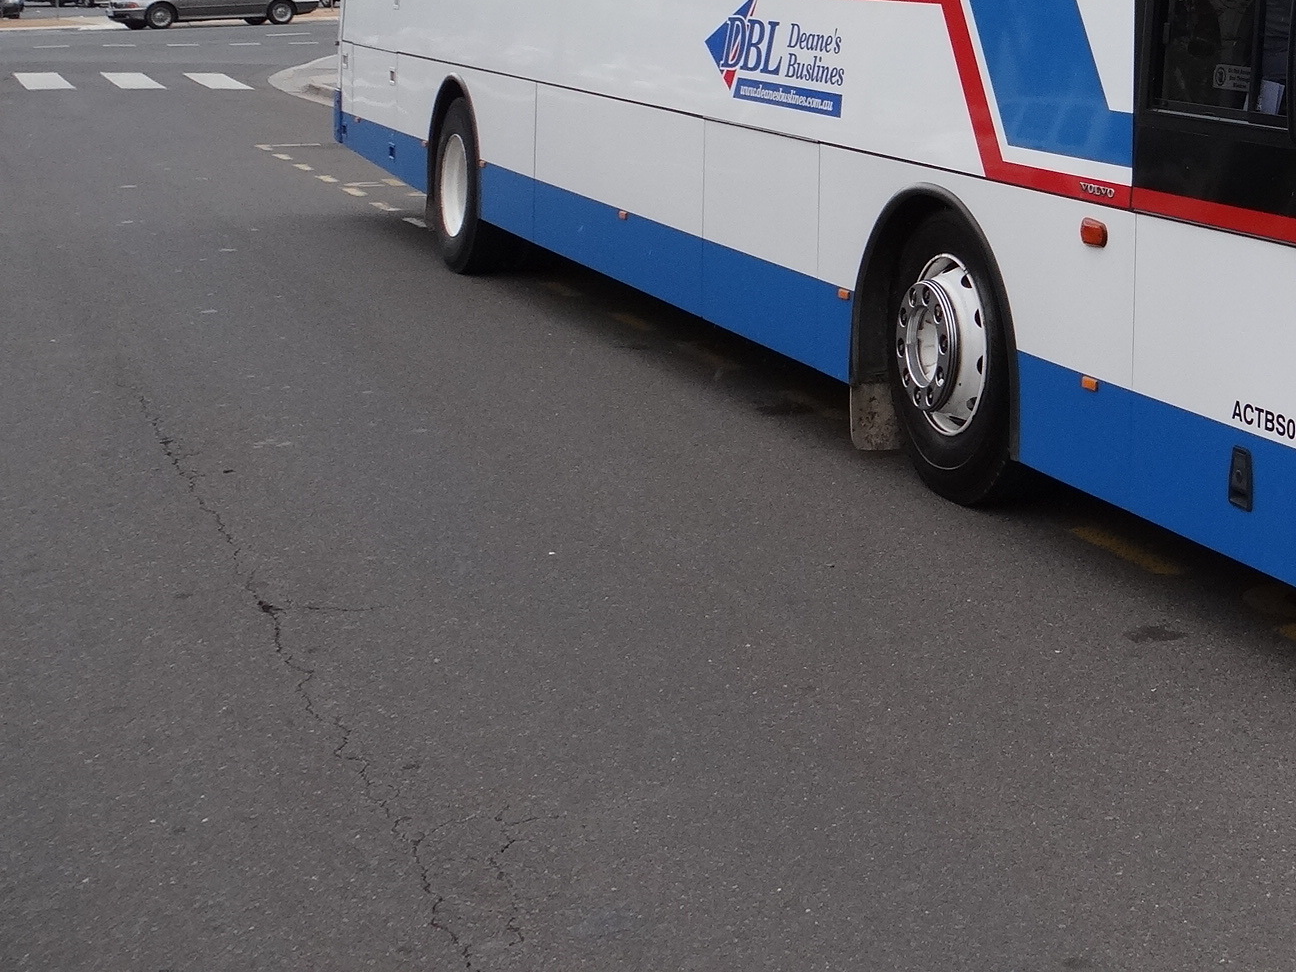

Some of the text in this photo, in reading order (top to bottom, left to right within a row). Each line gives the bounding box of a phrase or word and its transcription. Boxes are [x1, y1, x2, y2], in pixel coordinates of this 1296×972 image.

[720, 16, 842, 76] DBL Deane's
[785, 52, 845, 87] Buslines
[740, 84, 834, 111] www.deanesbuslines.com.au
[1079, 181, 1115, 198] VOLVO
